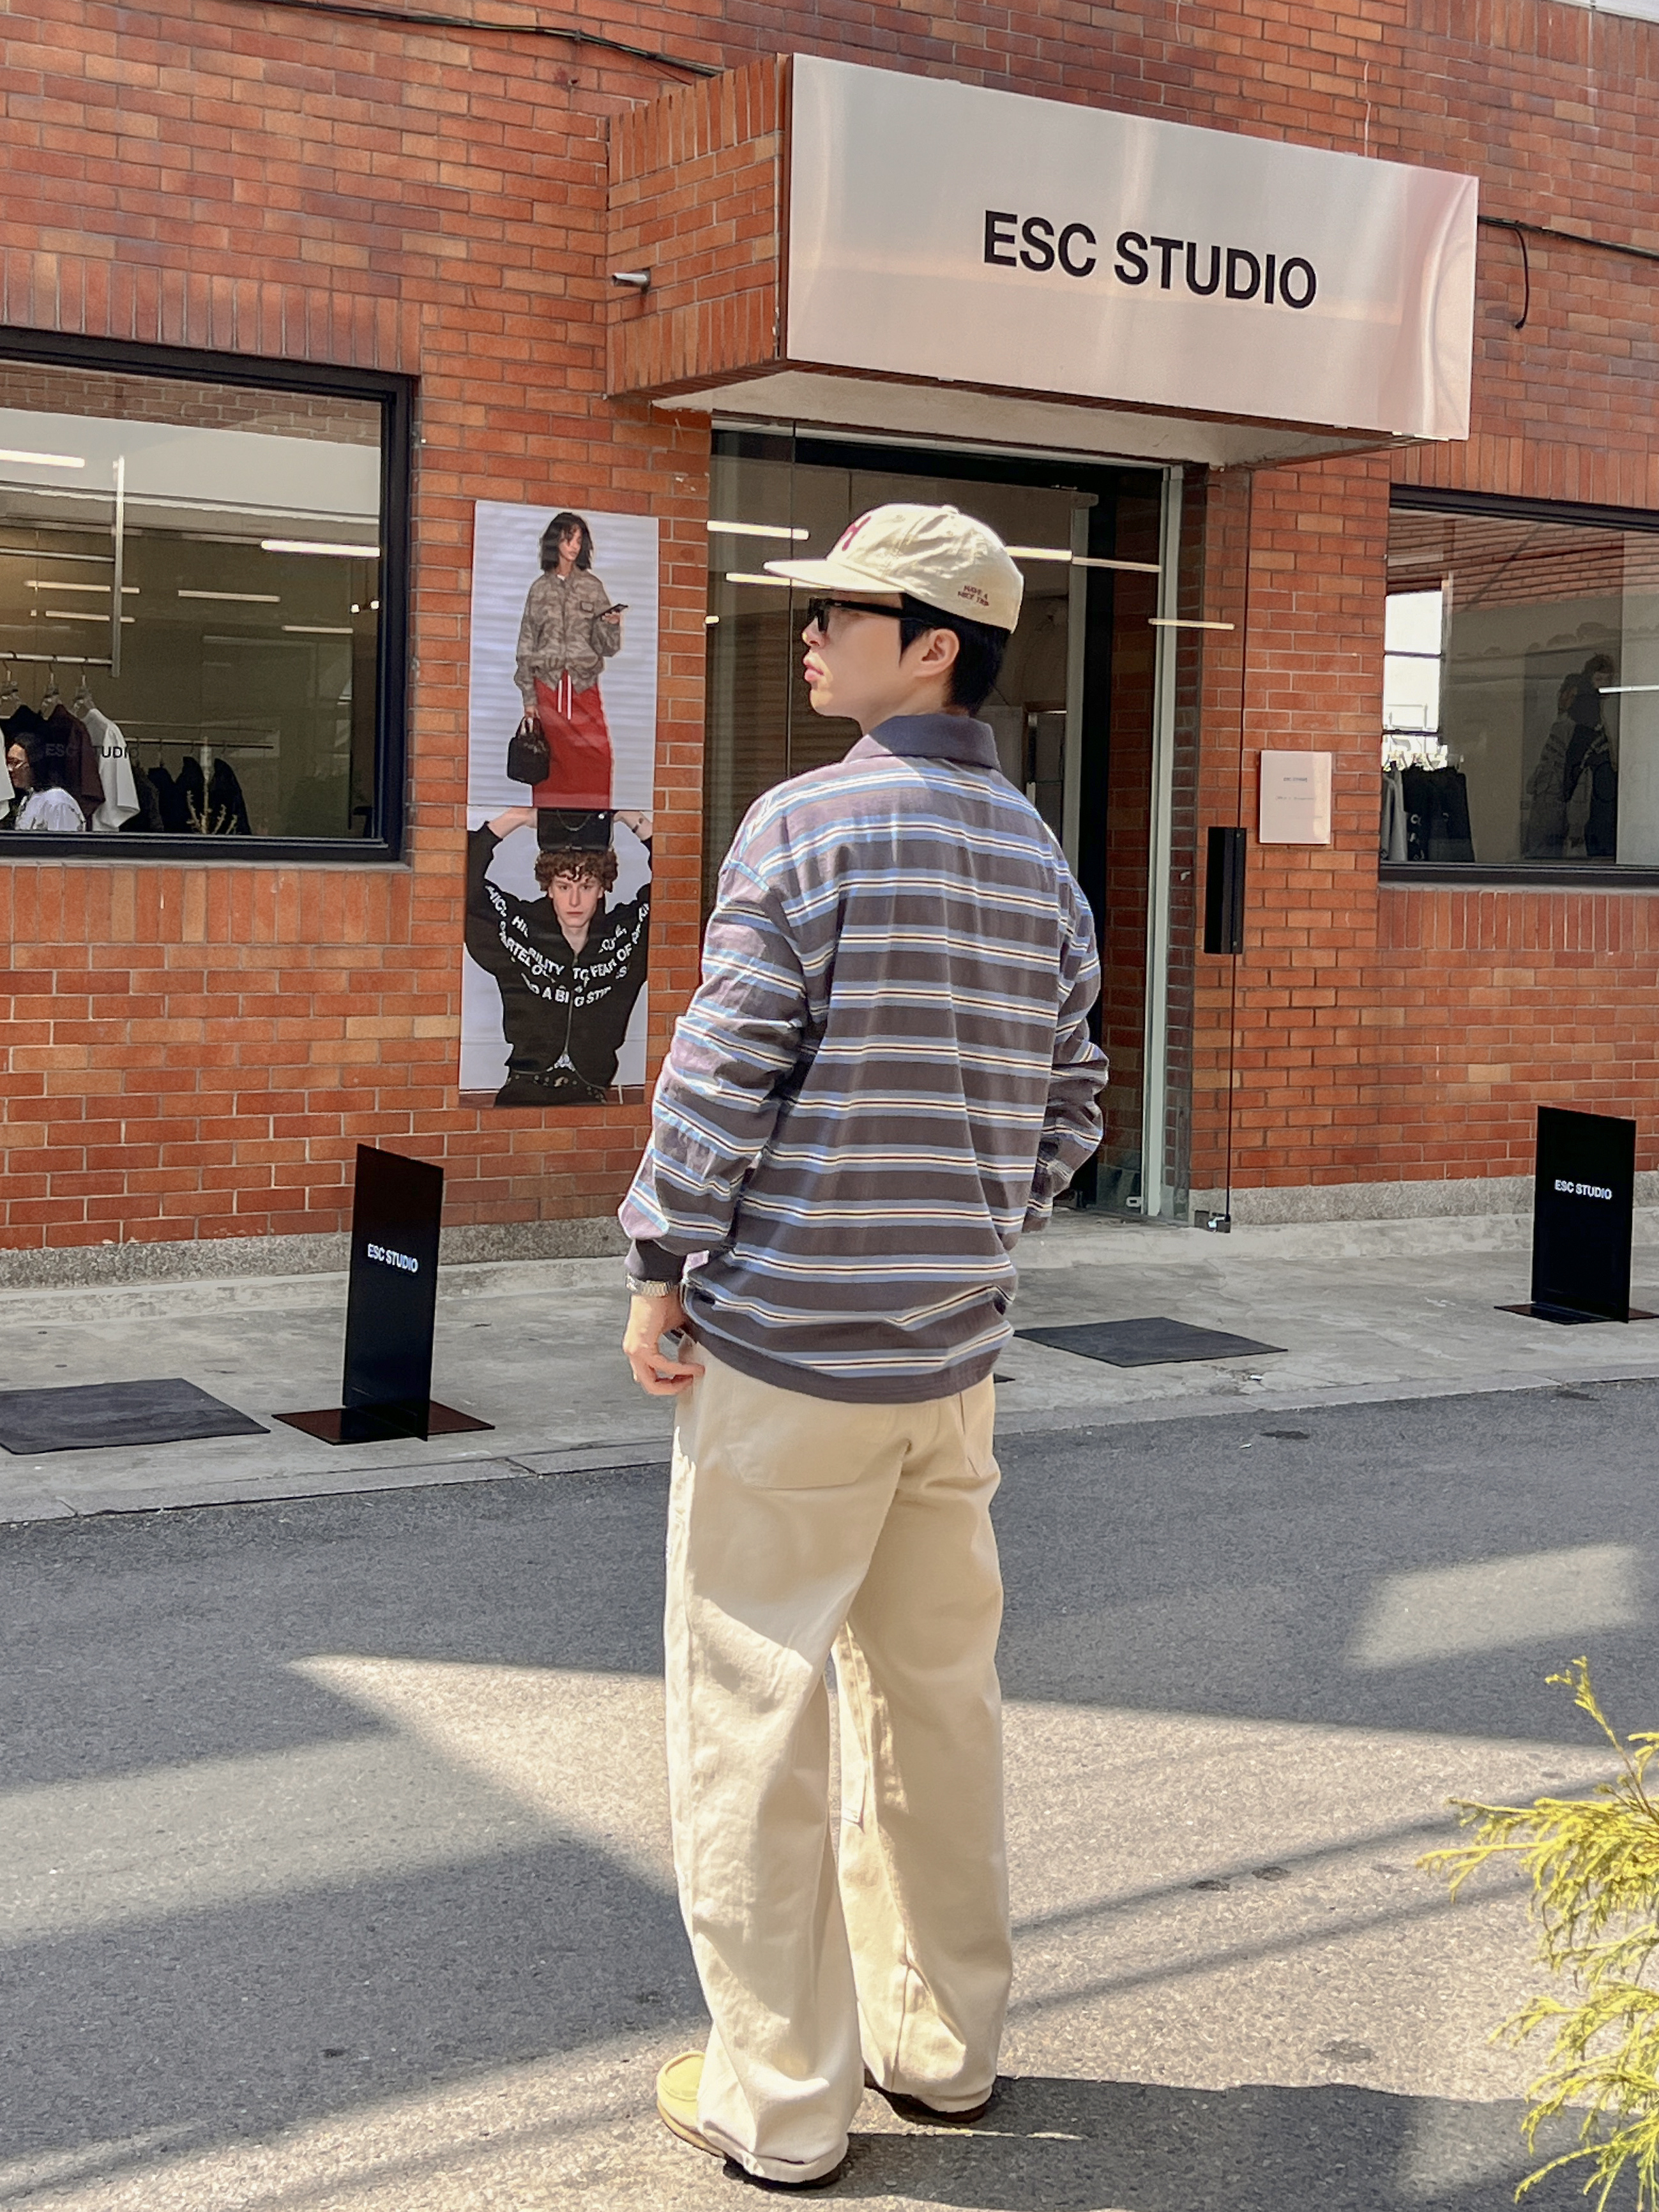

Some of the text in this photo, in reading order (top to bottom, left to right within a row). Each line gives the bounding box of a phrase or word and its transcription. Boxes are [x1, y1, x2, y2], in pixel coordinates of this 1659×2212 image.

[984, 209, 1317, 309] ESC STUDIO
[1554, 1179, 1612, 1200] ESC STUDIO
[367, 1243, 418, 1273] ESC STUDIO
